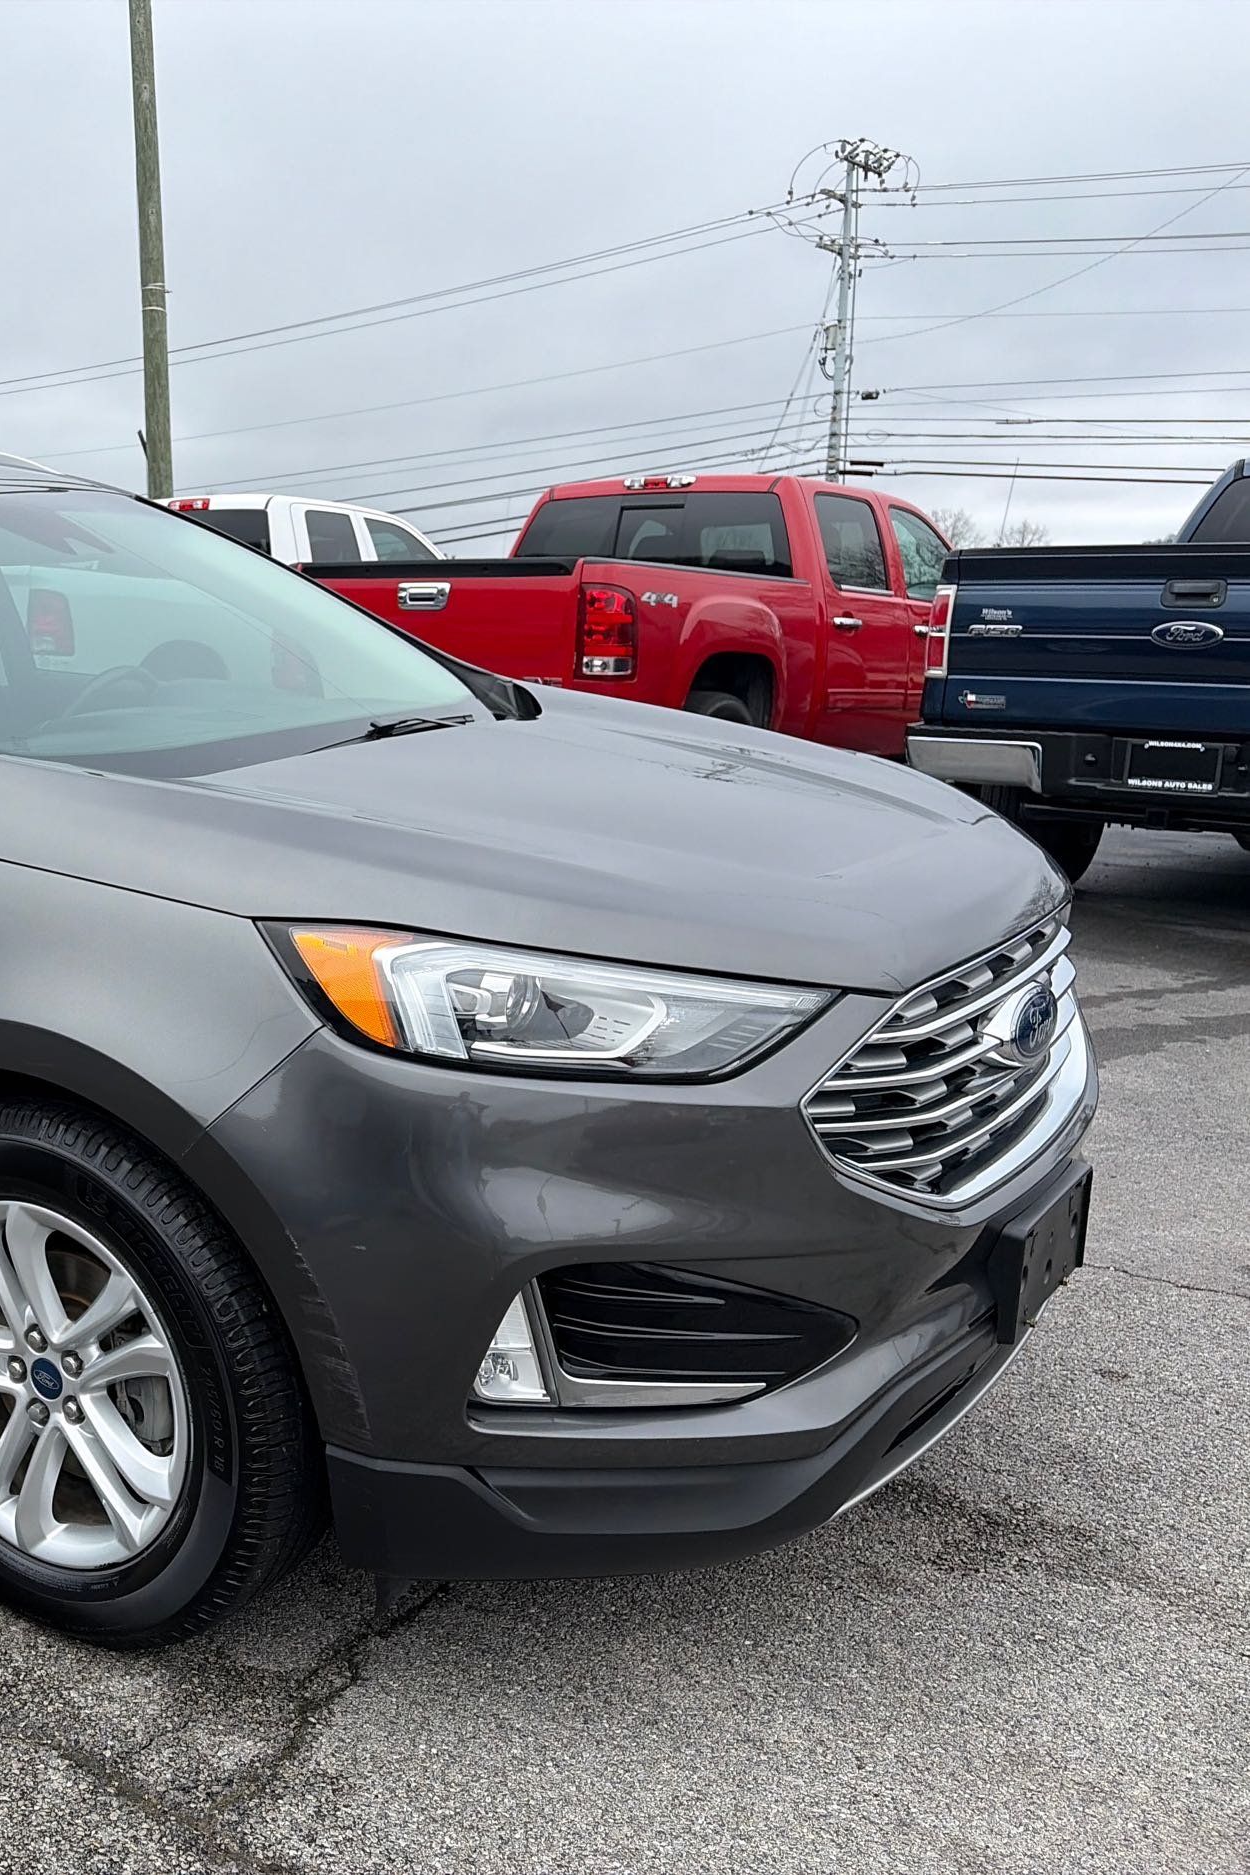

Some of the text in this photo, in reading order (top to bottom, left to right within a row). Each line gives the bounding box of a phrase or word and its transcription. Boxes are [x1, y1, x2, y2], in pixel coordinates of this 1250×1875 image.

[1165, 625, 1206, 641] Ford
[1163, 780, 1186, 789] AUTO
[1187, 782, 1213, 791] SALES
